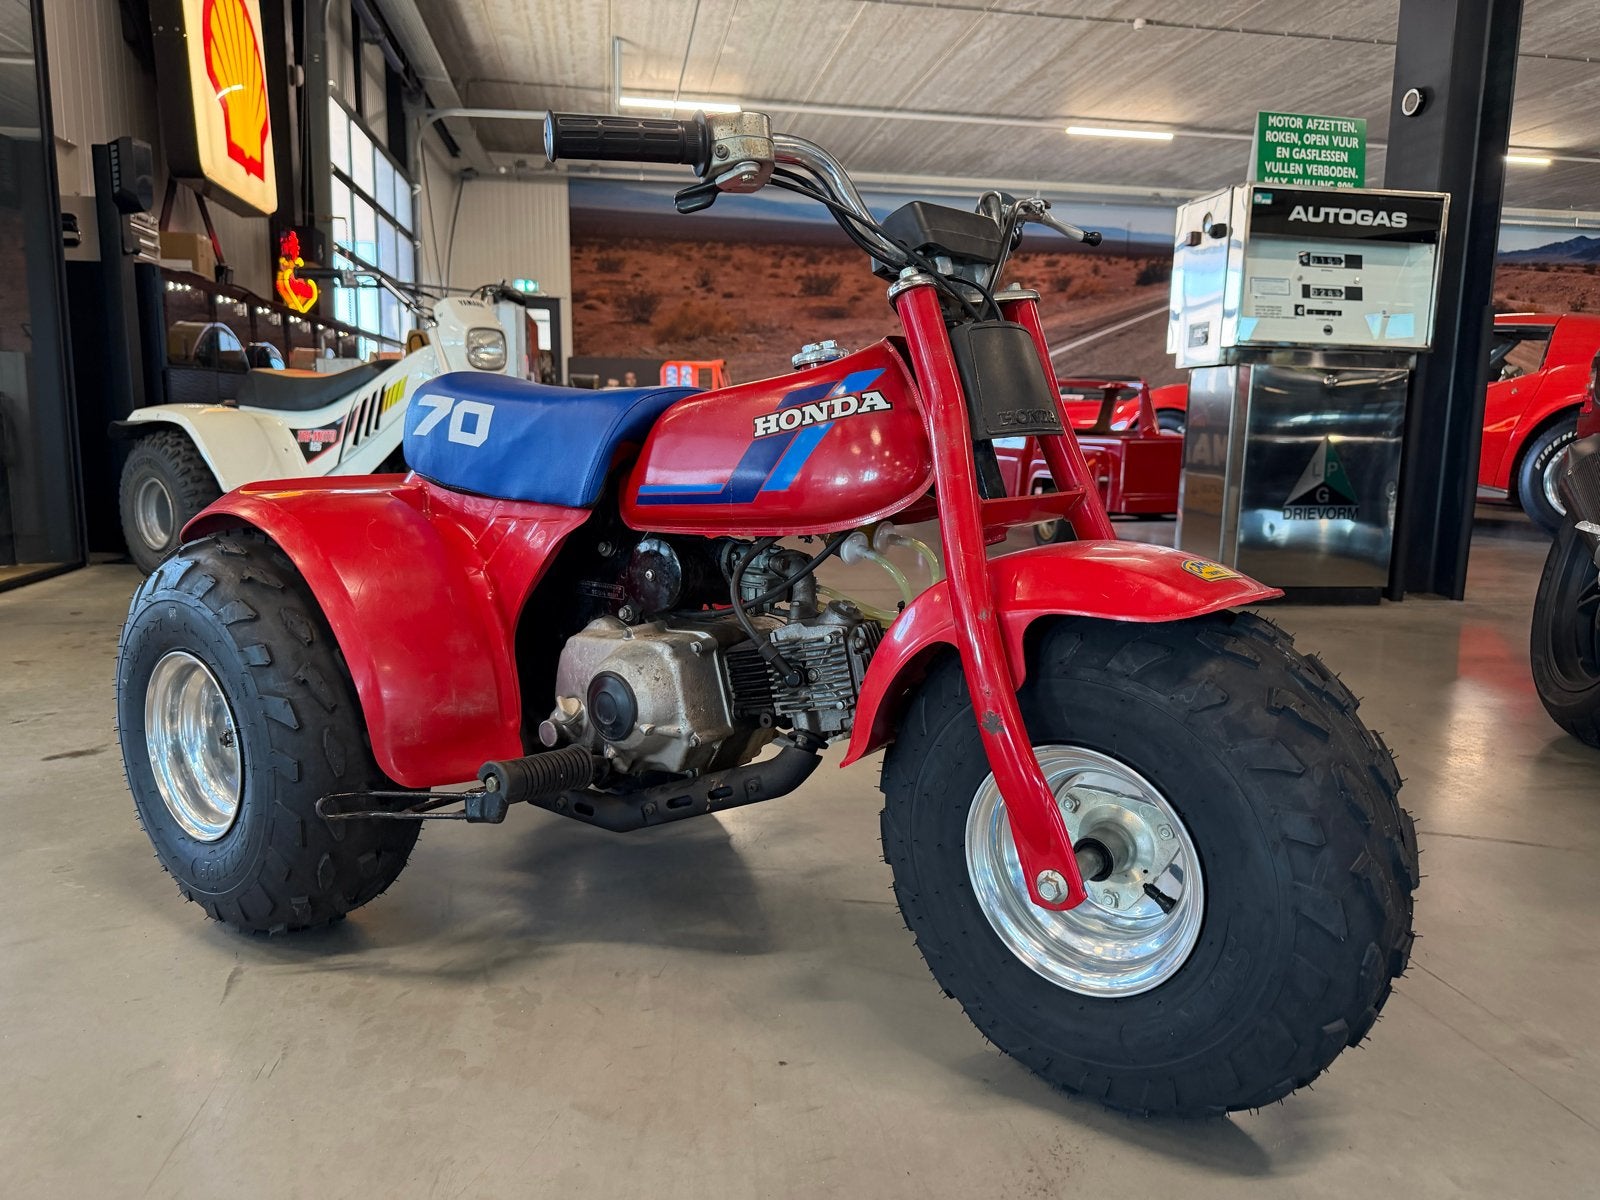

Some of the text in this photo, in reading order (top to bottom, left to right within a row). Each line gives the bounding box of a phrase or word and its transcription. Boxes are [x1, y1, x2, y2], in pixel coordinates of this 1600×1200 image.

[1268, 115, 1358, 133] MOTOR AFZETTEN.
[1265, 130, 1359, 149] ROKEN, OPEN VUUR
[1276, 146, 1348, 163] EN GASFLESSEN
[1265, 161, 1359, 179] VULLEN VERBODEN.
[1287, 205, 1408, 228] AUTOGAS
[412, 393, 495, 448] 70
[753, 390, 892, 438] HONDA
[996, 408, 1057, 426] HONDA
[1534, 431, 1578, 470] FIREH
[1282, 506, 1359, 520] DRIEVORM
